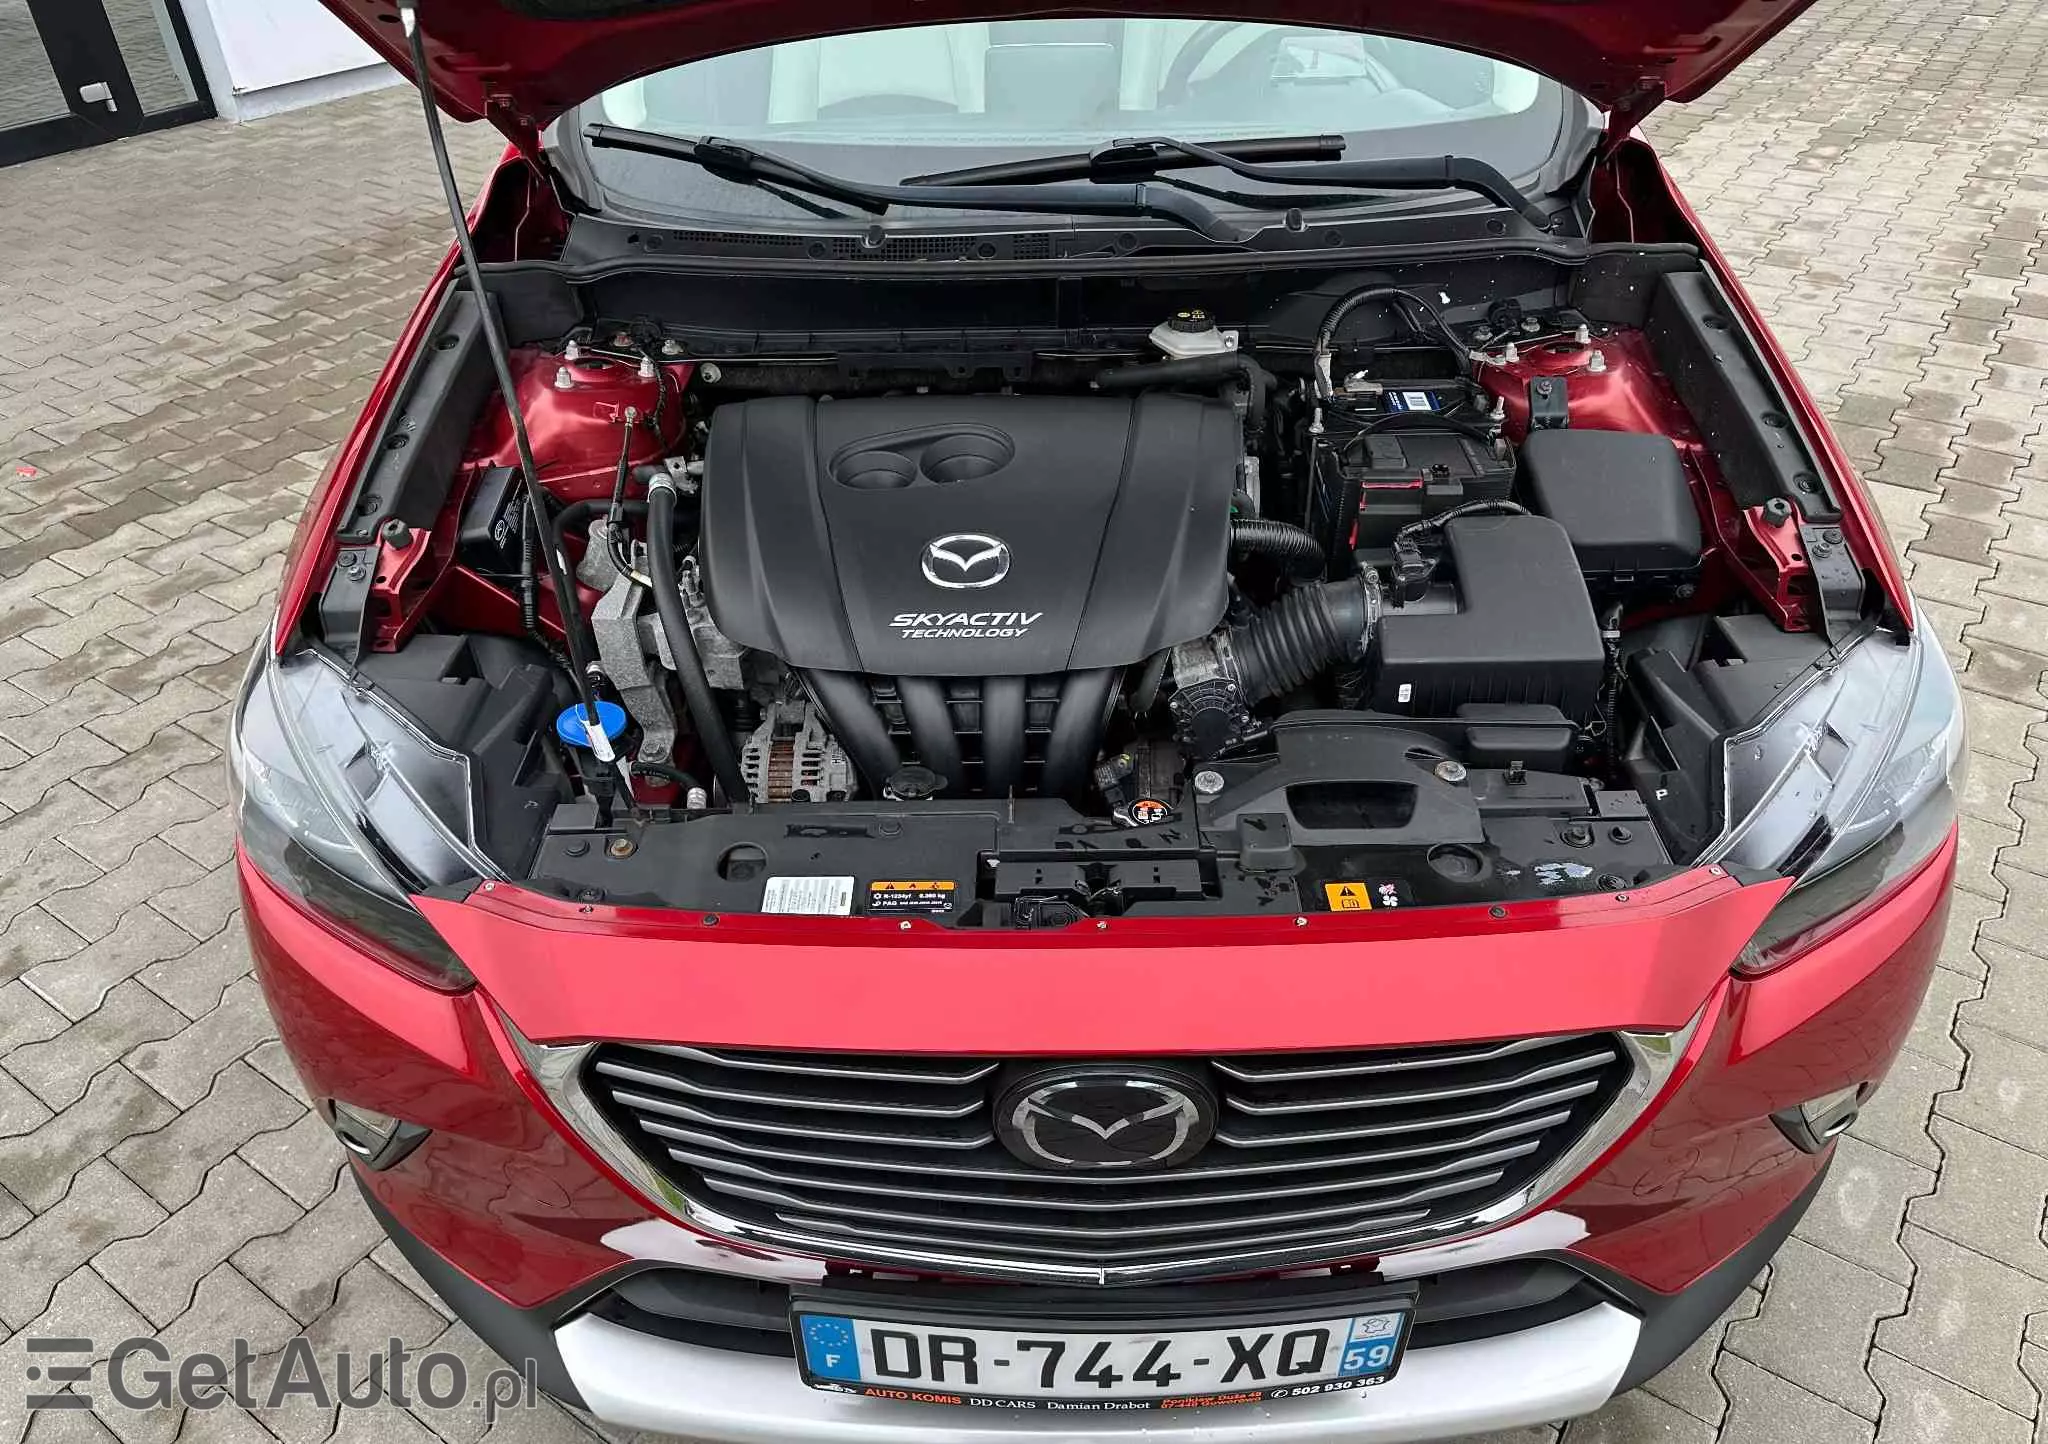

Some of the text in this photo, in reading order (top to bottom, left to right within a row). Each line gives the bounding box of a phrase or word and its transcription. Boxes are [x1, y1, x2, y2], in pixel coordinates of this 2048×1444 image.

[888, 612, 1044, 627] SKYACTIV
[901, 628, 1029, 639] TECHNOLOGY
[825, 1353, 841, 1368] F
[870, 1327, 1331, 1389] DR-744-XQ
[1343, 1344, 1390, 1371] 59
[1291, 1376, 1385, 1396] 502 930 363
[864, 1387, 1151, 1410] AUTO KOMIS DD CARS Damian Drabot
